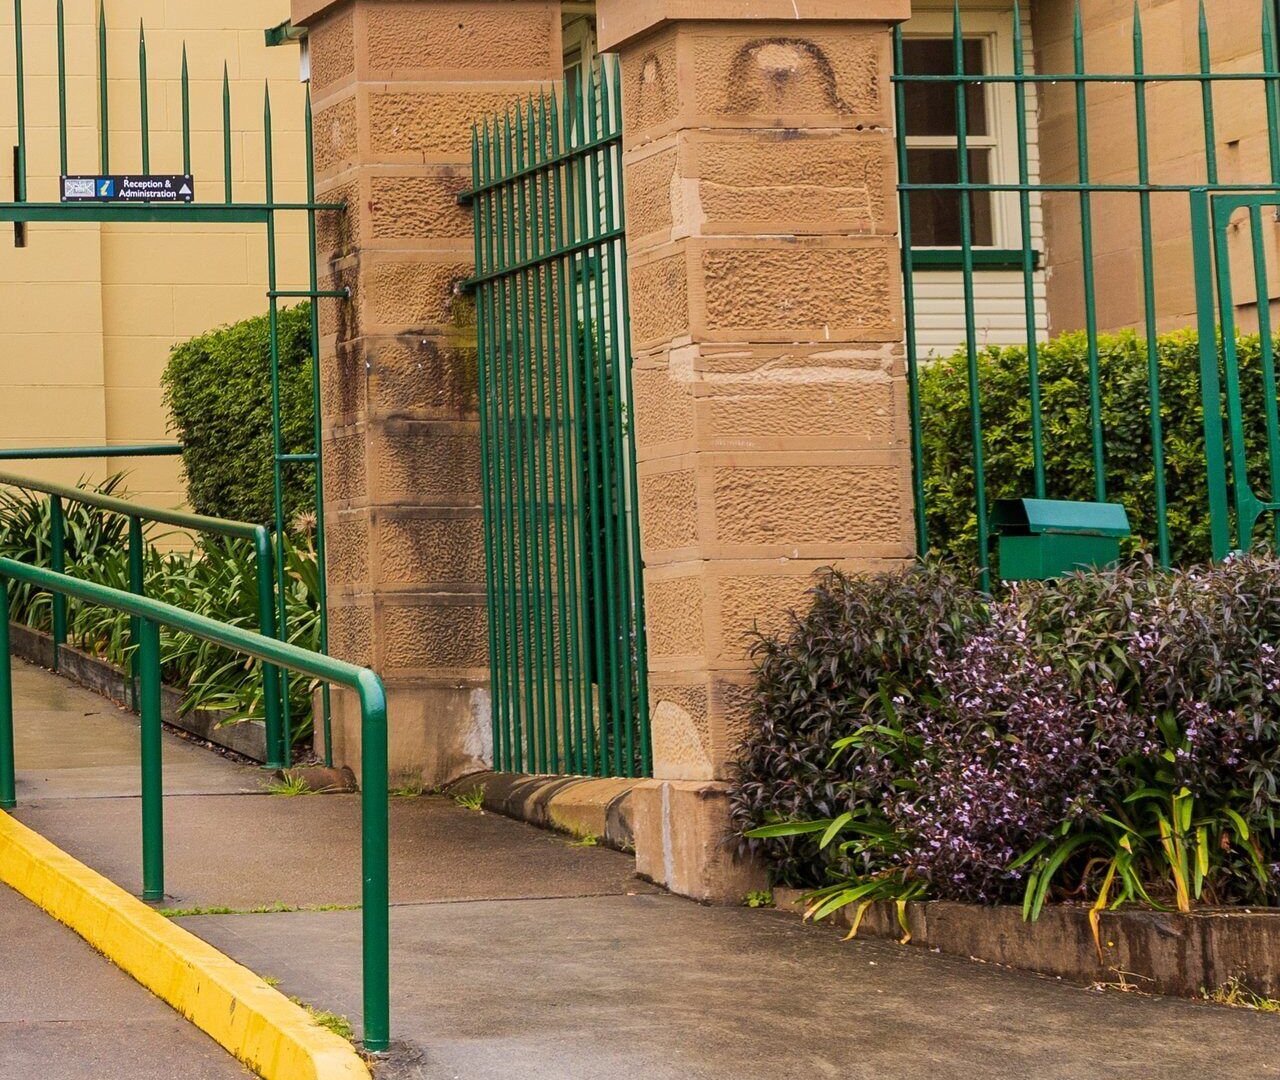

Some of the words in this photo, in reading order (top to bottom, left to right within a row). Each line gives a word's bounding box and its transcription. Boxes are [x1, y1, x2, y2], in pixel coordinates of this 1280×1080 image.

[123, 179, 163, 190] Reception
[164, 180, 171, 188] &
[118, 188, 177, 198] Administration
